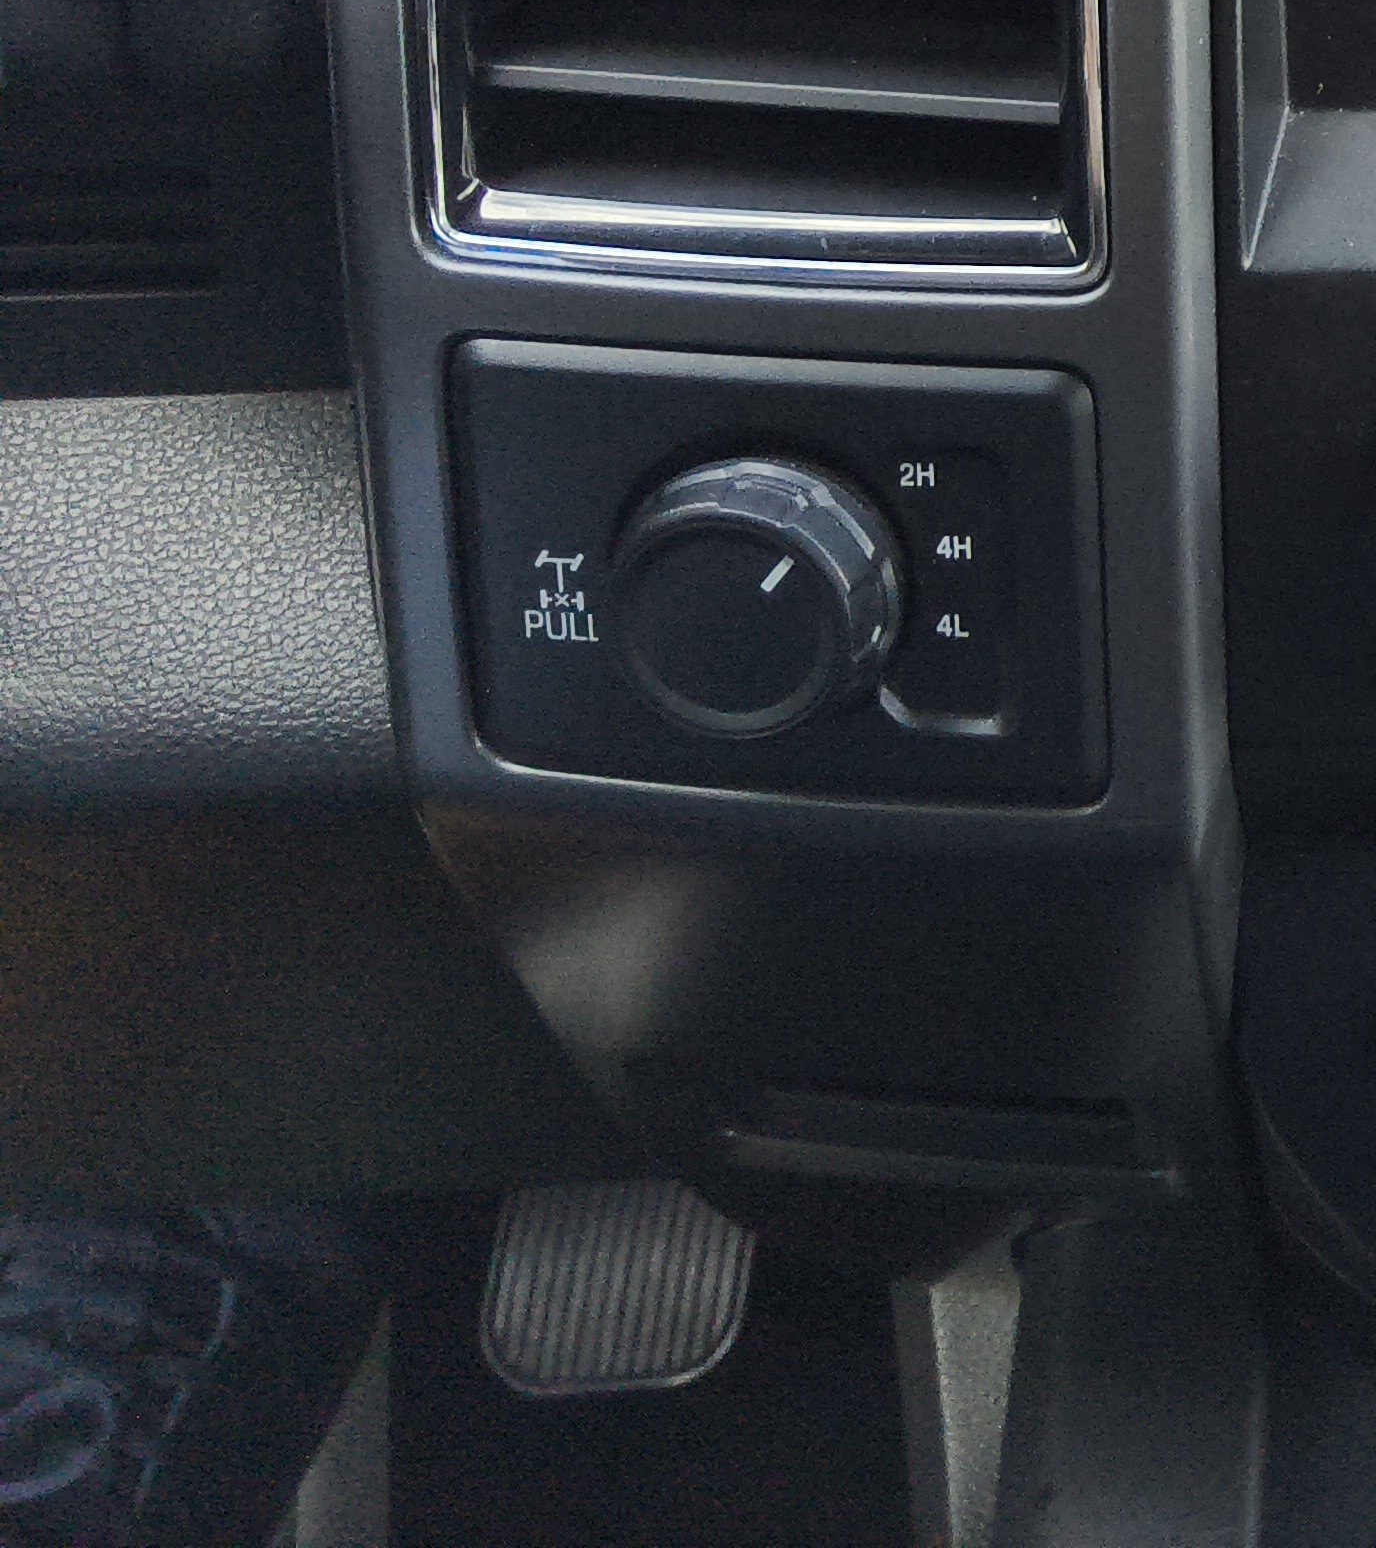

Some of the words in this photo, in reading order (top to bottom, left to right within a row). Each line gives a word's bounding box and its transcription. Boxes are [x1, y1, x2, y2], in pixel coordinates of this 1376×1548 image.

[900, 462, 936, 488] 2H
[936, 535, 972, 561] 4H
[525, 609, 599, 643] PULL
[936, 613, 970, 639] 4L
